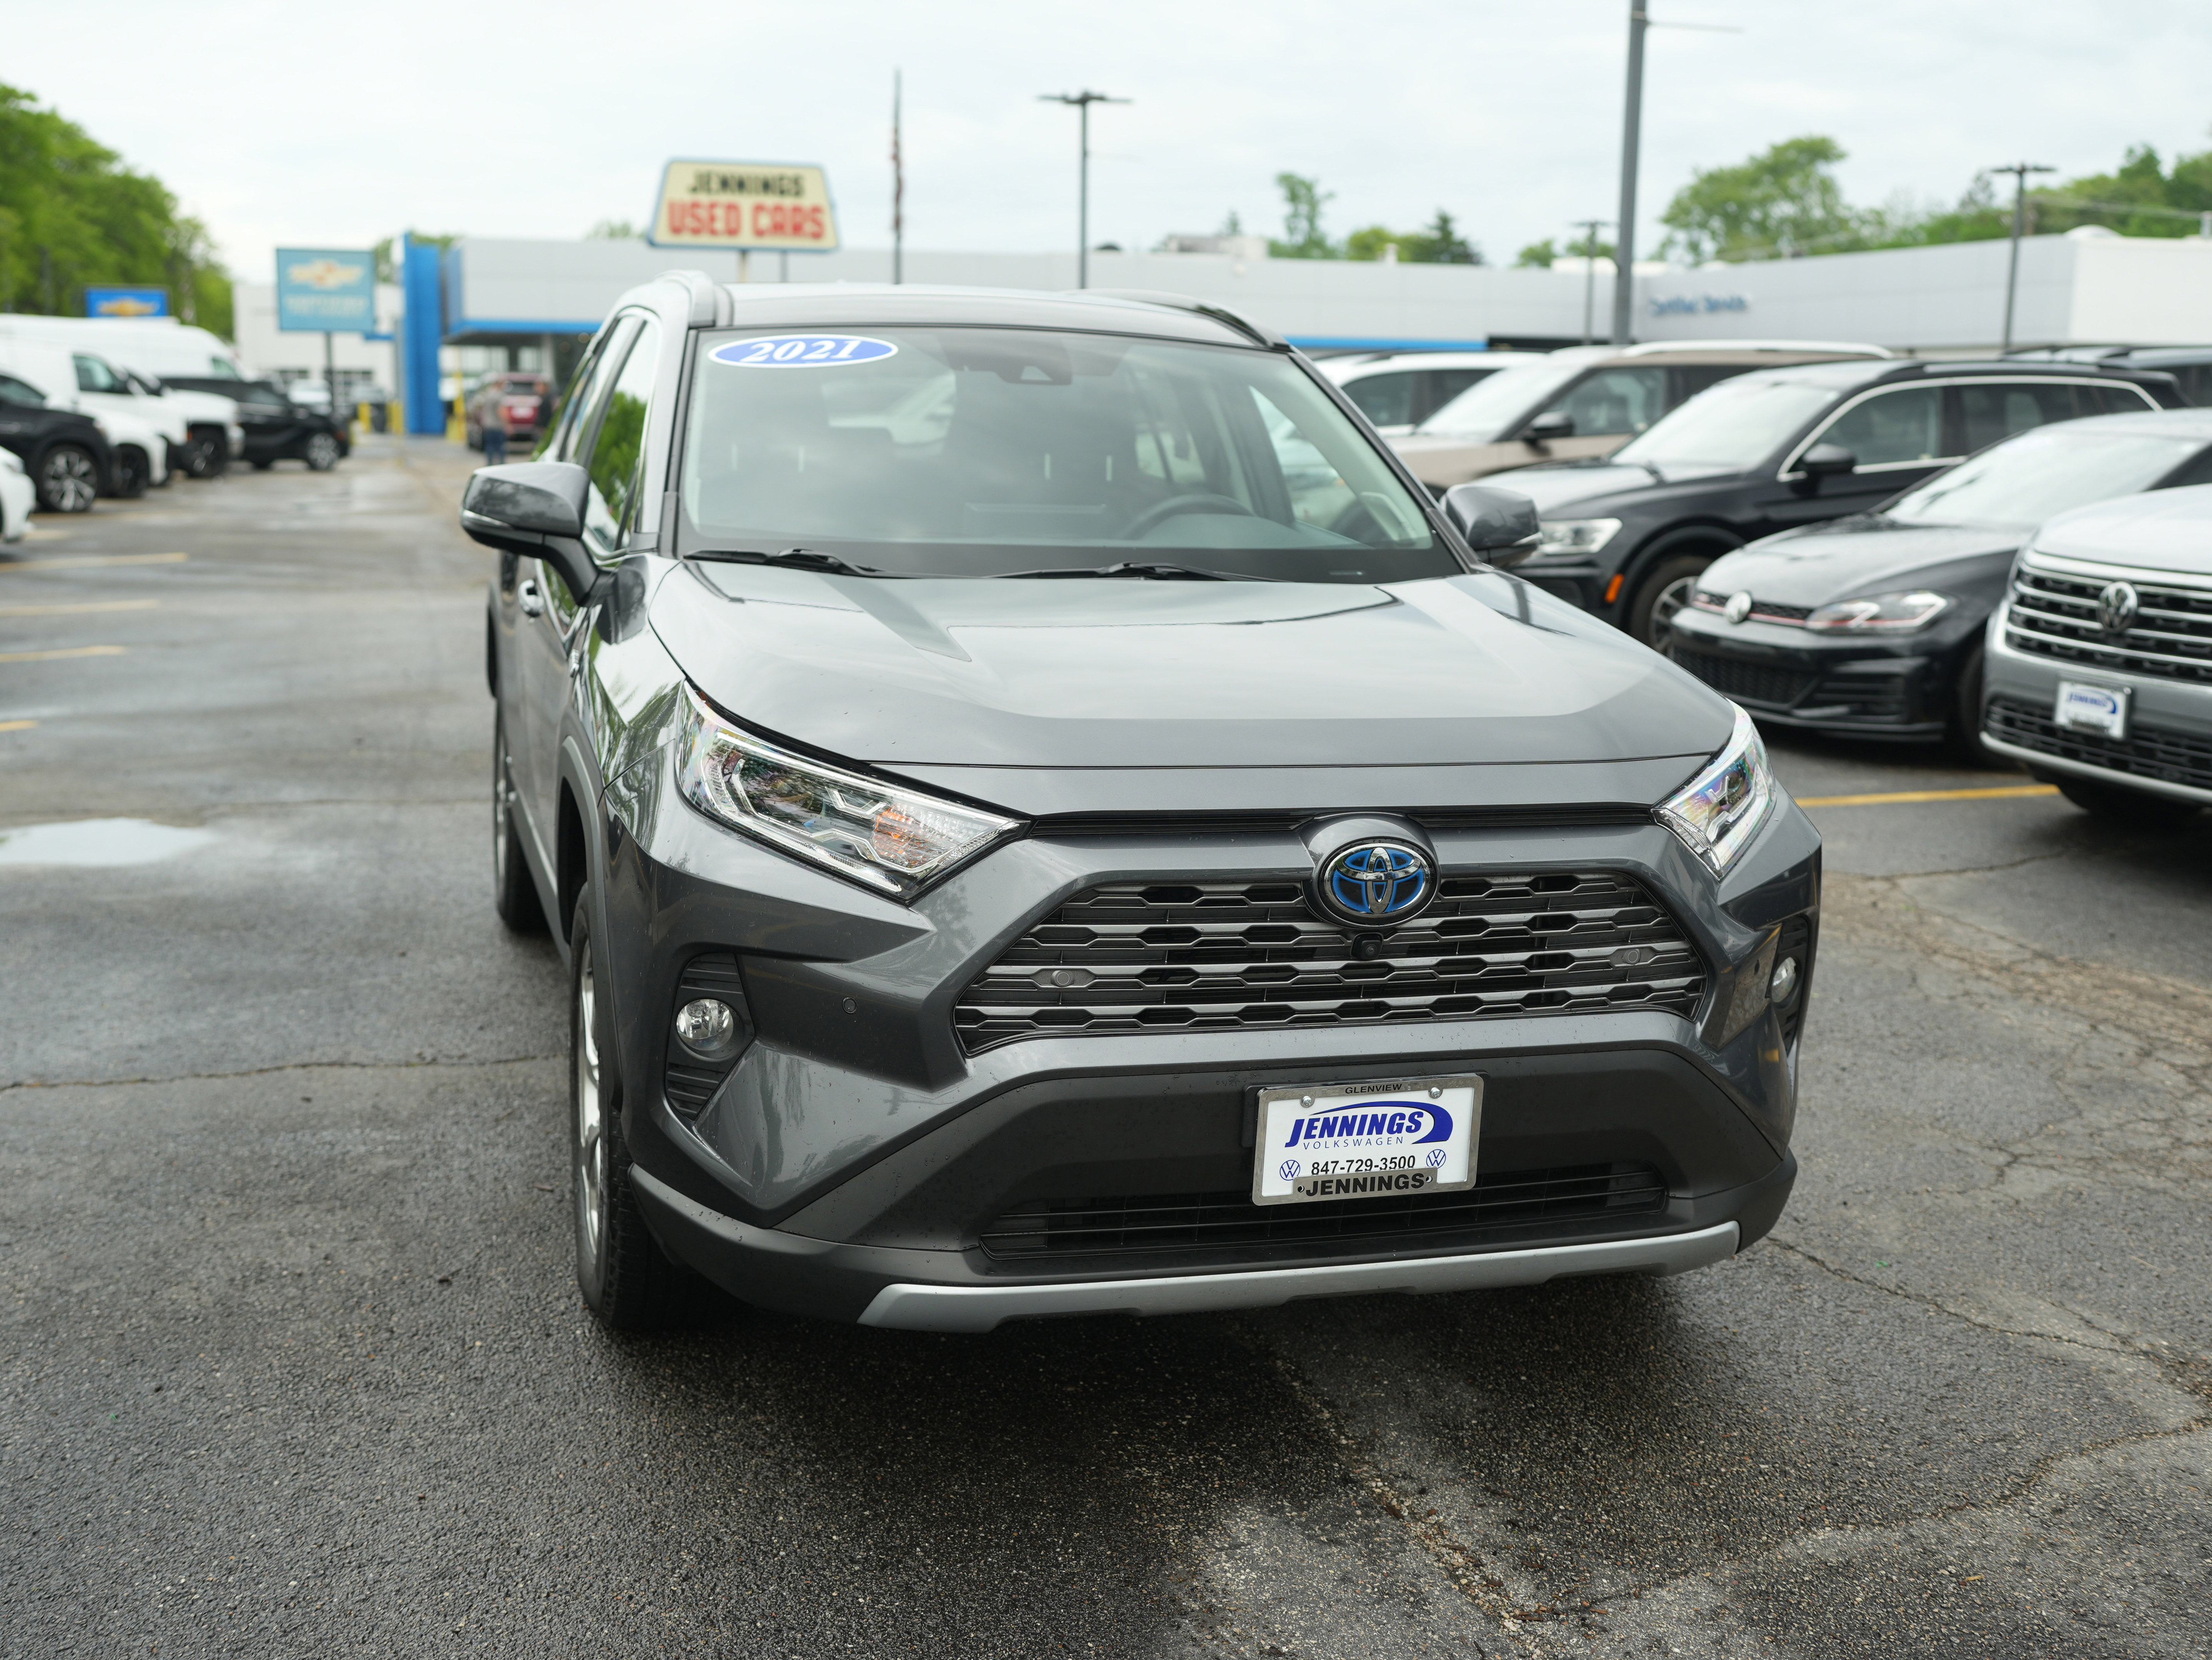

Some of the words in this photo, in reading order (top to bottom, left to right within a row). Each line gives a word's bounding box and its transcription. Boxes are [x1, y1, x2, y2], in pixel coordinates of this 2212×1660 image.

[690, 172, 803, 196] JENNINGS
[668, 201, 741, 235] USED
[752, 203, 825, 240] CARS
[739, 339, 862, 362] 2021
[1345, 1084, 1403, 1094] GLENVIEW
[1284, 1111, 1424, 1148] JENNINGS
[1303, 1136, 1403, 1150] VOLKSWAGEN
[1311, 1155, 1416, 1175] 847-729-3500
[1306, 1173, 1424, 1197] JENNINGS
